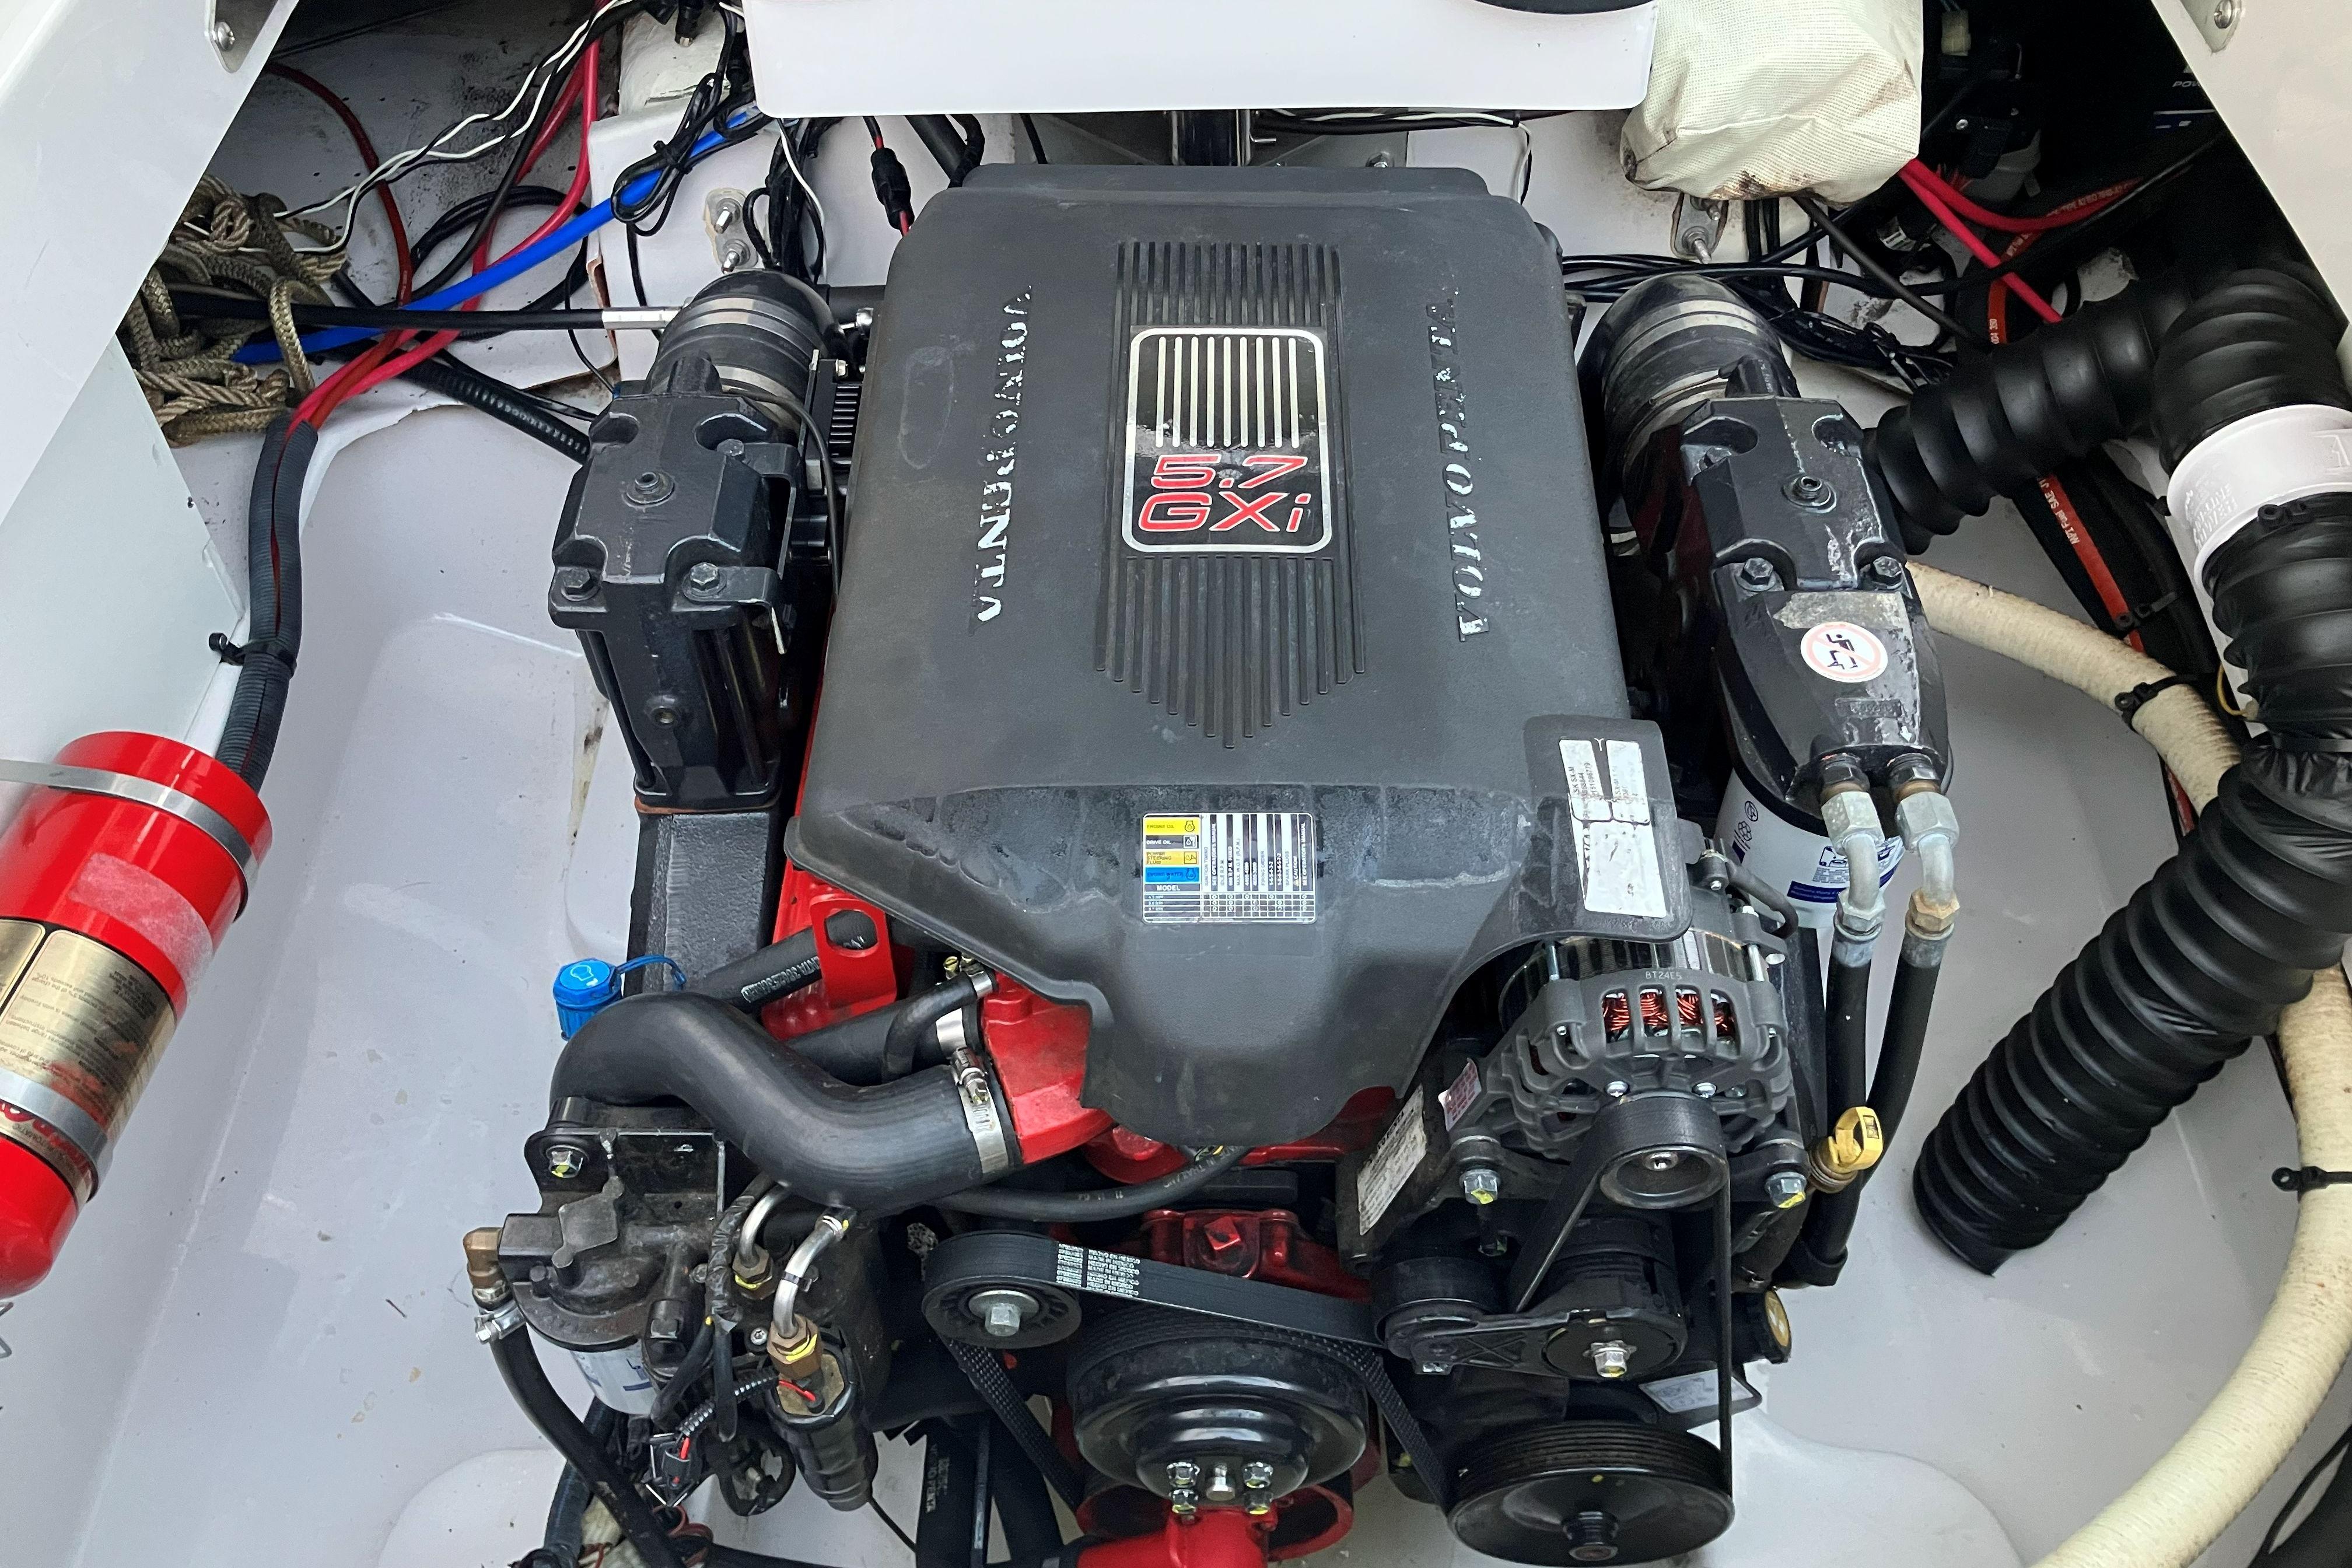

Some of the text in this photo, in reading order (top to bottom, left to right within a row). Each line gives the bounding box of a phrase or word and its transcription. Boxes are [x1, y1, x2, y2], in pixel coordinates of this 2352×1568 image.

[967, 285, 1031, 636] VOLVO PENTA
[1151, 454, 1308, 489] 5.7
[1426, 299, 1489, 642] VOLVO PENTA
[1138, 492, 1311, 532] GXi
[2045, 490, 2059, 509] SAE
[1645, 971, 1682, 980] BT24E5
